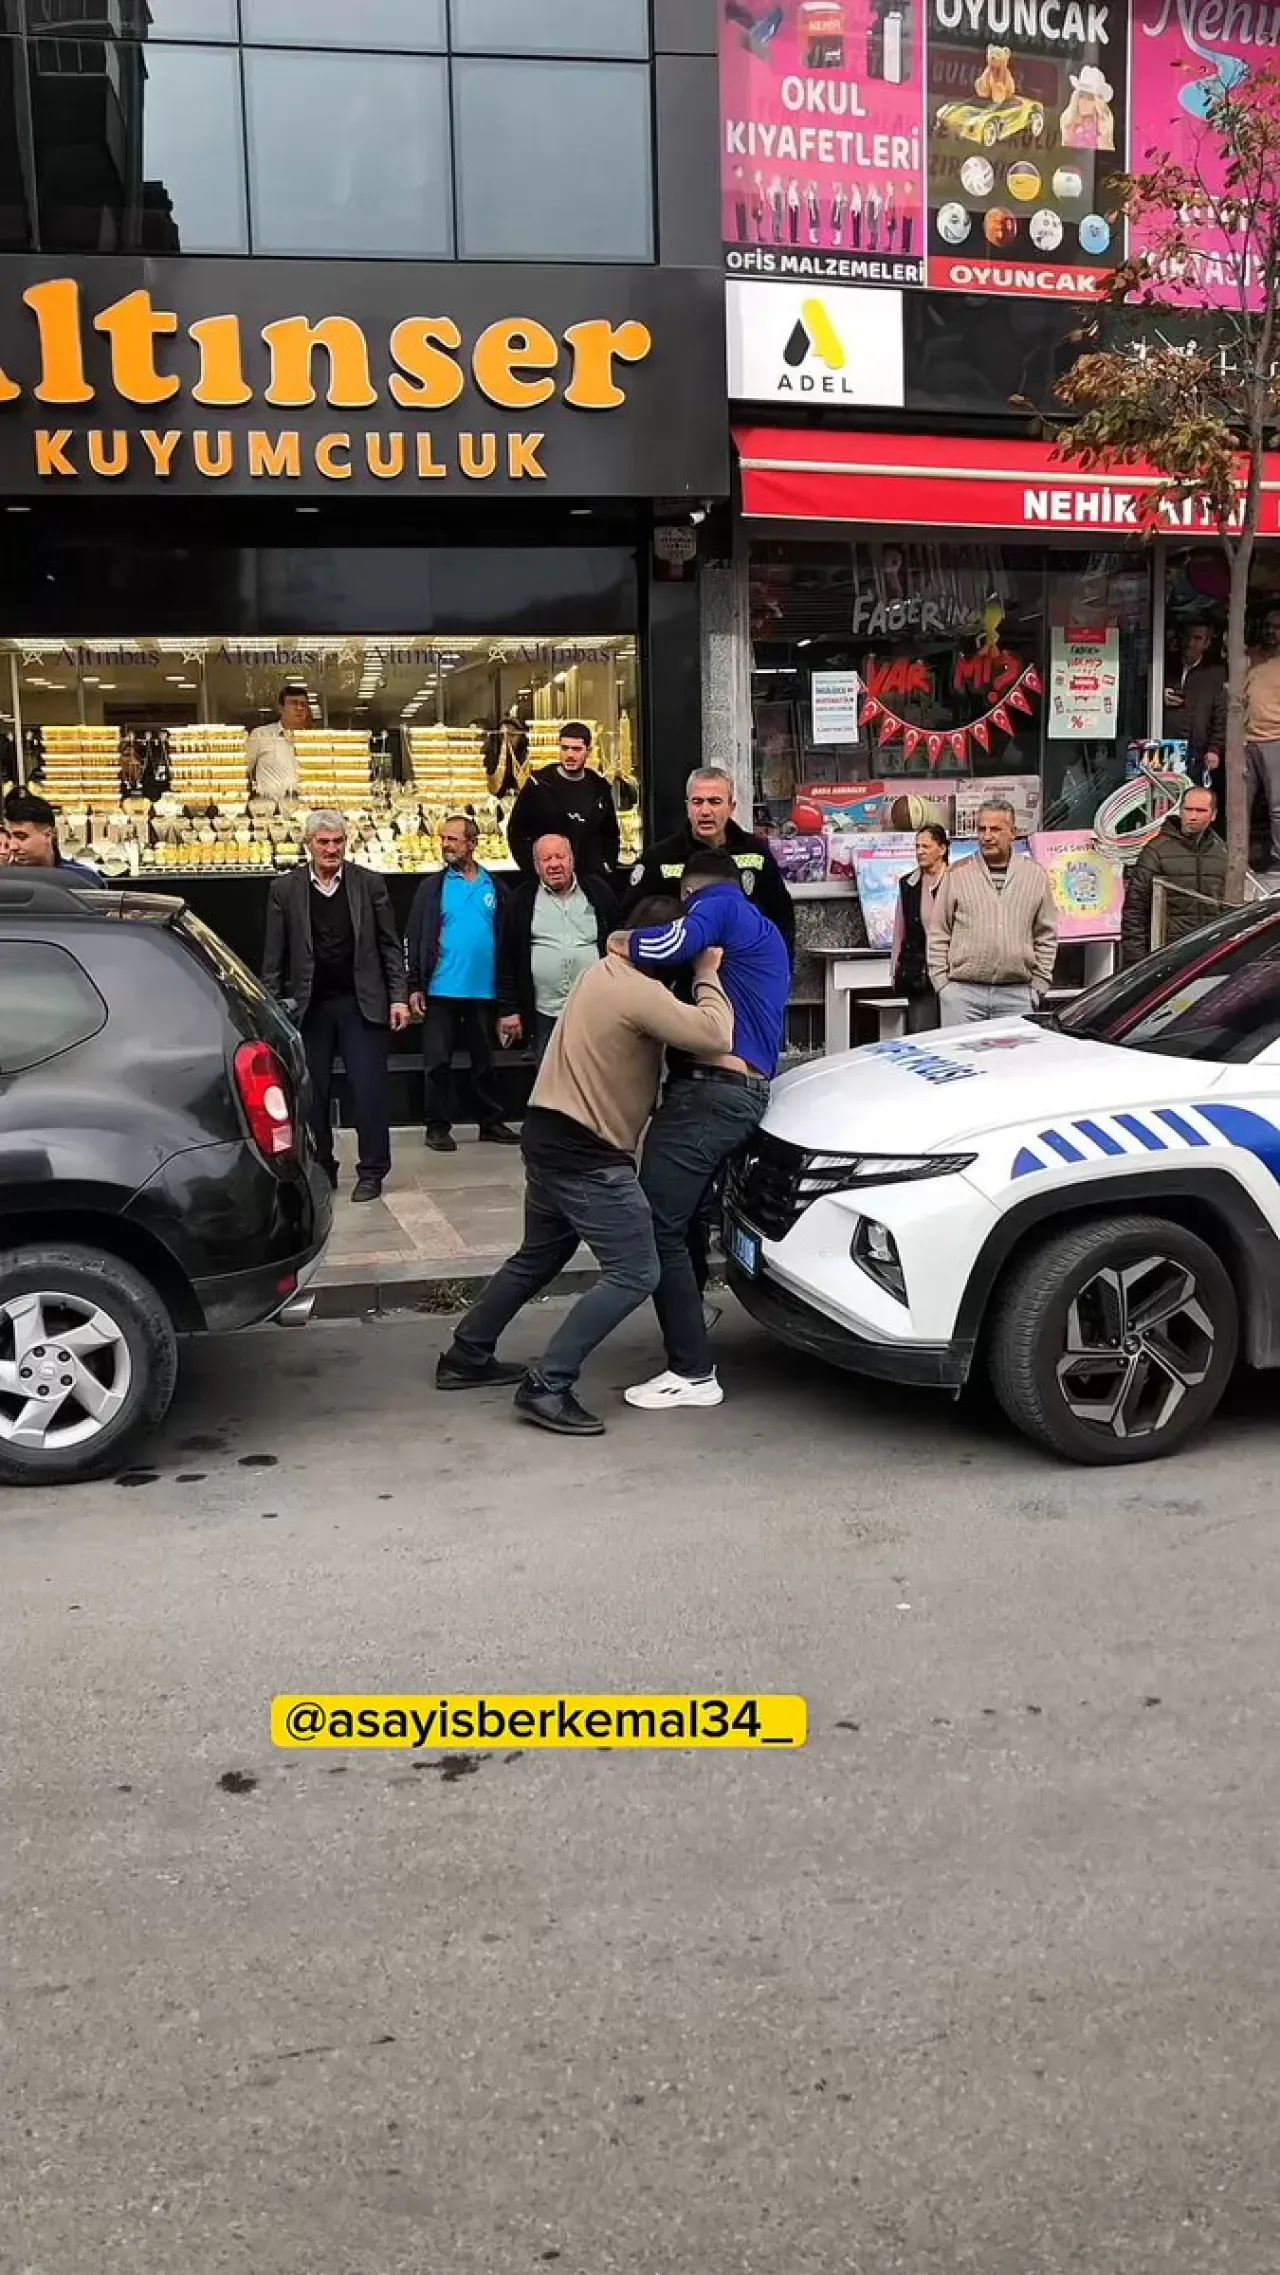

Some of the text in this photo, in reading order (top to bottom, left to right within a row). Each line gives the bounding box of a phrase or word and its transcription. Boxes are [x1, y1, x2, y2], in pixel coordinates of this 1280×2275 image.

[936, 0, 1111, 45] OYUNCAK
[781, 74, 867, 117] OKUL
[725, 118, 920, 171] KIYAFETLERİ
[726, 247, 925, 283] OFİS MALZEMELERİ
[949, 264, 1098, 293] OYUNCAK
[0, 277, 652, 409] ltınser
[777, 373, 854, 394] ADEL
[34, 428, 548, 479] KUYUMCULUK
[1023, 486, 1138, 524] NEHİR
